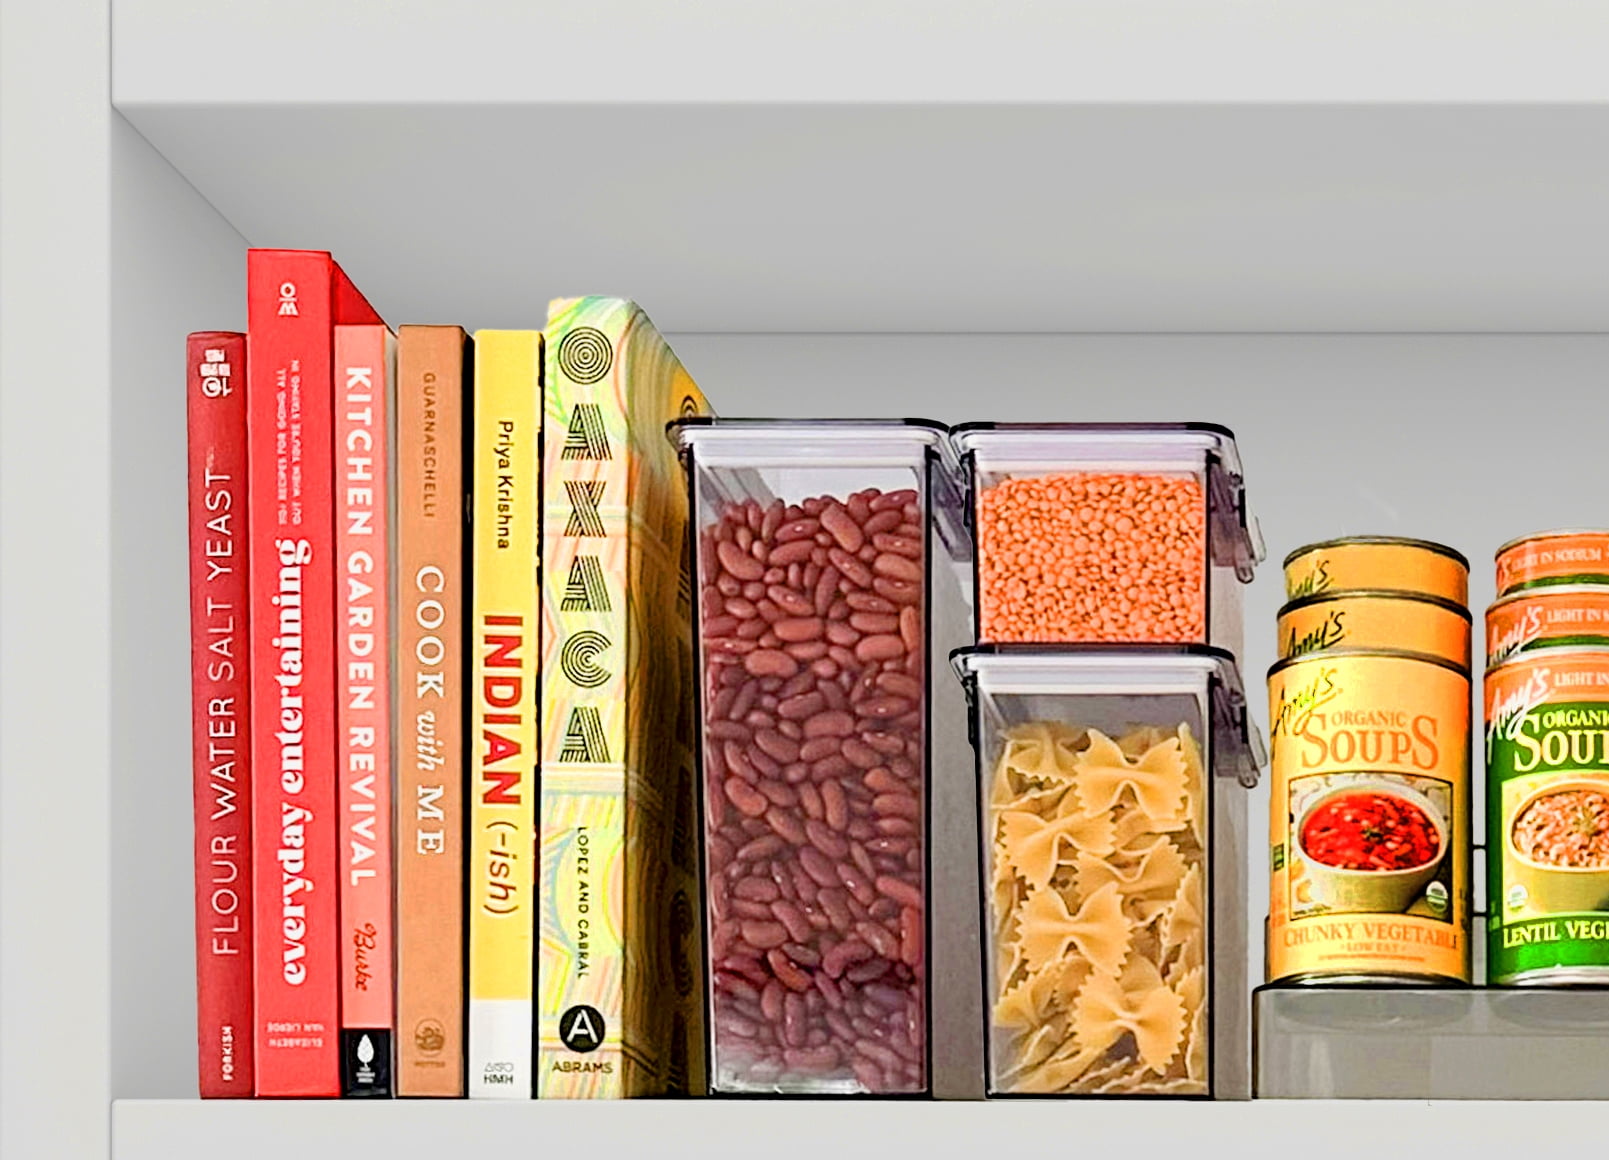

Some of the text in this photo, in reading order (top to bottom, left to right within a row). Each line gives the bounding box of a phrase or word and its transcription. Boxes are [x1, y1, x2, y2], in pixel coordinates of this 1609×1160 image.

[277, 432, 288, 455] FOR
[423, 372, 437, 518] GUARNASCHELLI
[277, 456, 288, 501] RECIPES
[497, 420, 514, 549] Priya Krishna
[558, 326, 613, 763] OAXACA
[346, 366, 376, 887] KITCHEN GARDEN REVIVAL
[1547, 608, 1585, 623] LIGHT
[1586, 608, 1601, 622] IN
[204, 466, 239, 955] FLOUR WATER SALT YEAST
[415, 565, 446, 856] COOK with ME
[1554, 672, 1594, 687] LIGHT
[1301, 713, 1440, 771] SOUPS
[1331, 709, 1407, 728] ORGANIC
[271, 538, 315, 986] everyday entertaining
[482, 614, 524, 918] INDIAN (-ish)
[577, 826, 590, 979] LOPEZ AND CABRAL
[354, 922, 376, 992] Burke
[1284, 924, 1359, 948] CHUNKY
[1503, 921, 1561, 949] LENTIL
[222, 1025, 234, 1082] FORKISH
[551, 1060, 613, 1074] ABRAMS
